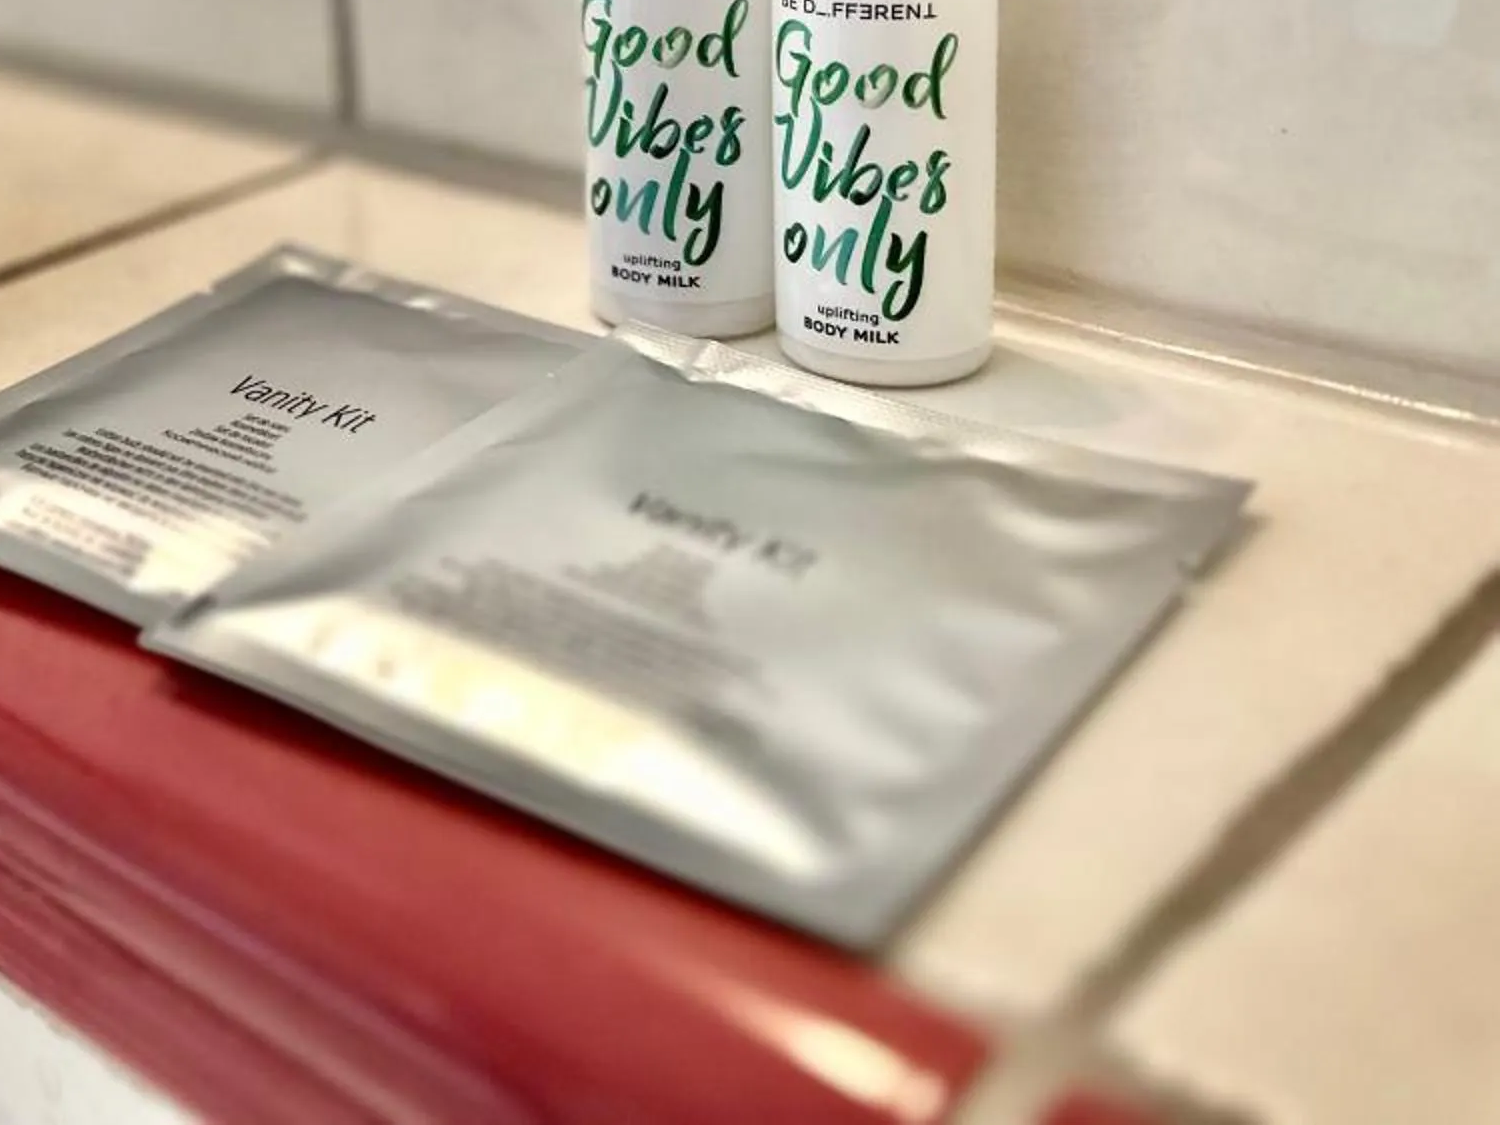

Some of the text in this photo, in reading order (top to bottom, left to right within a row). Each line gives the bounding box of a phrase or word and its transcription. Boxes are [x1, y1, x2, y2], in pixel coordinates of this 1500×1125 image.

[776, 19, 959, 120] Good
[585, 59, 746, 166] Vibes
[774, 96, 951, 214] Vibes
[591, 148, 725, 266] only
[611, 265, 701, 288] BODY MILK
[623, 254, 682, 271] uplifting
[784, 194, 928, 322] only
[804, 316, 900, 344] BODY MILK
[817, 304, 880, 325] uplifting
[230, 374, 376, 433] Vanity Kit
